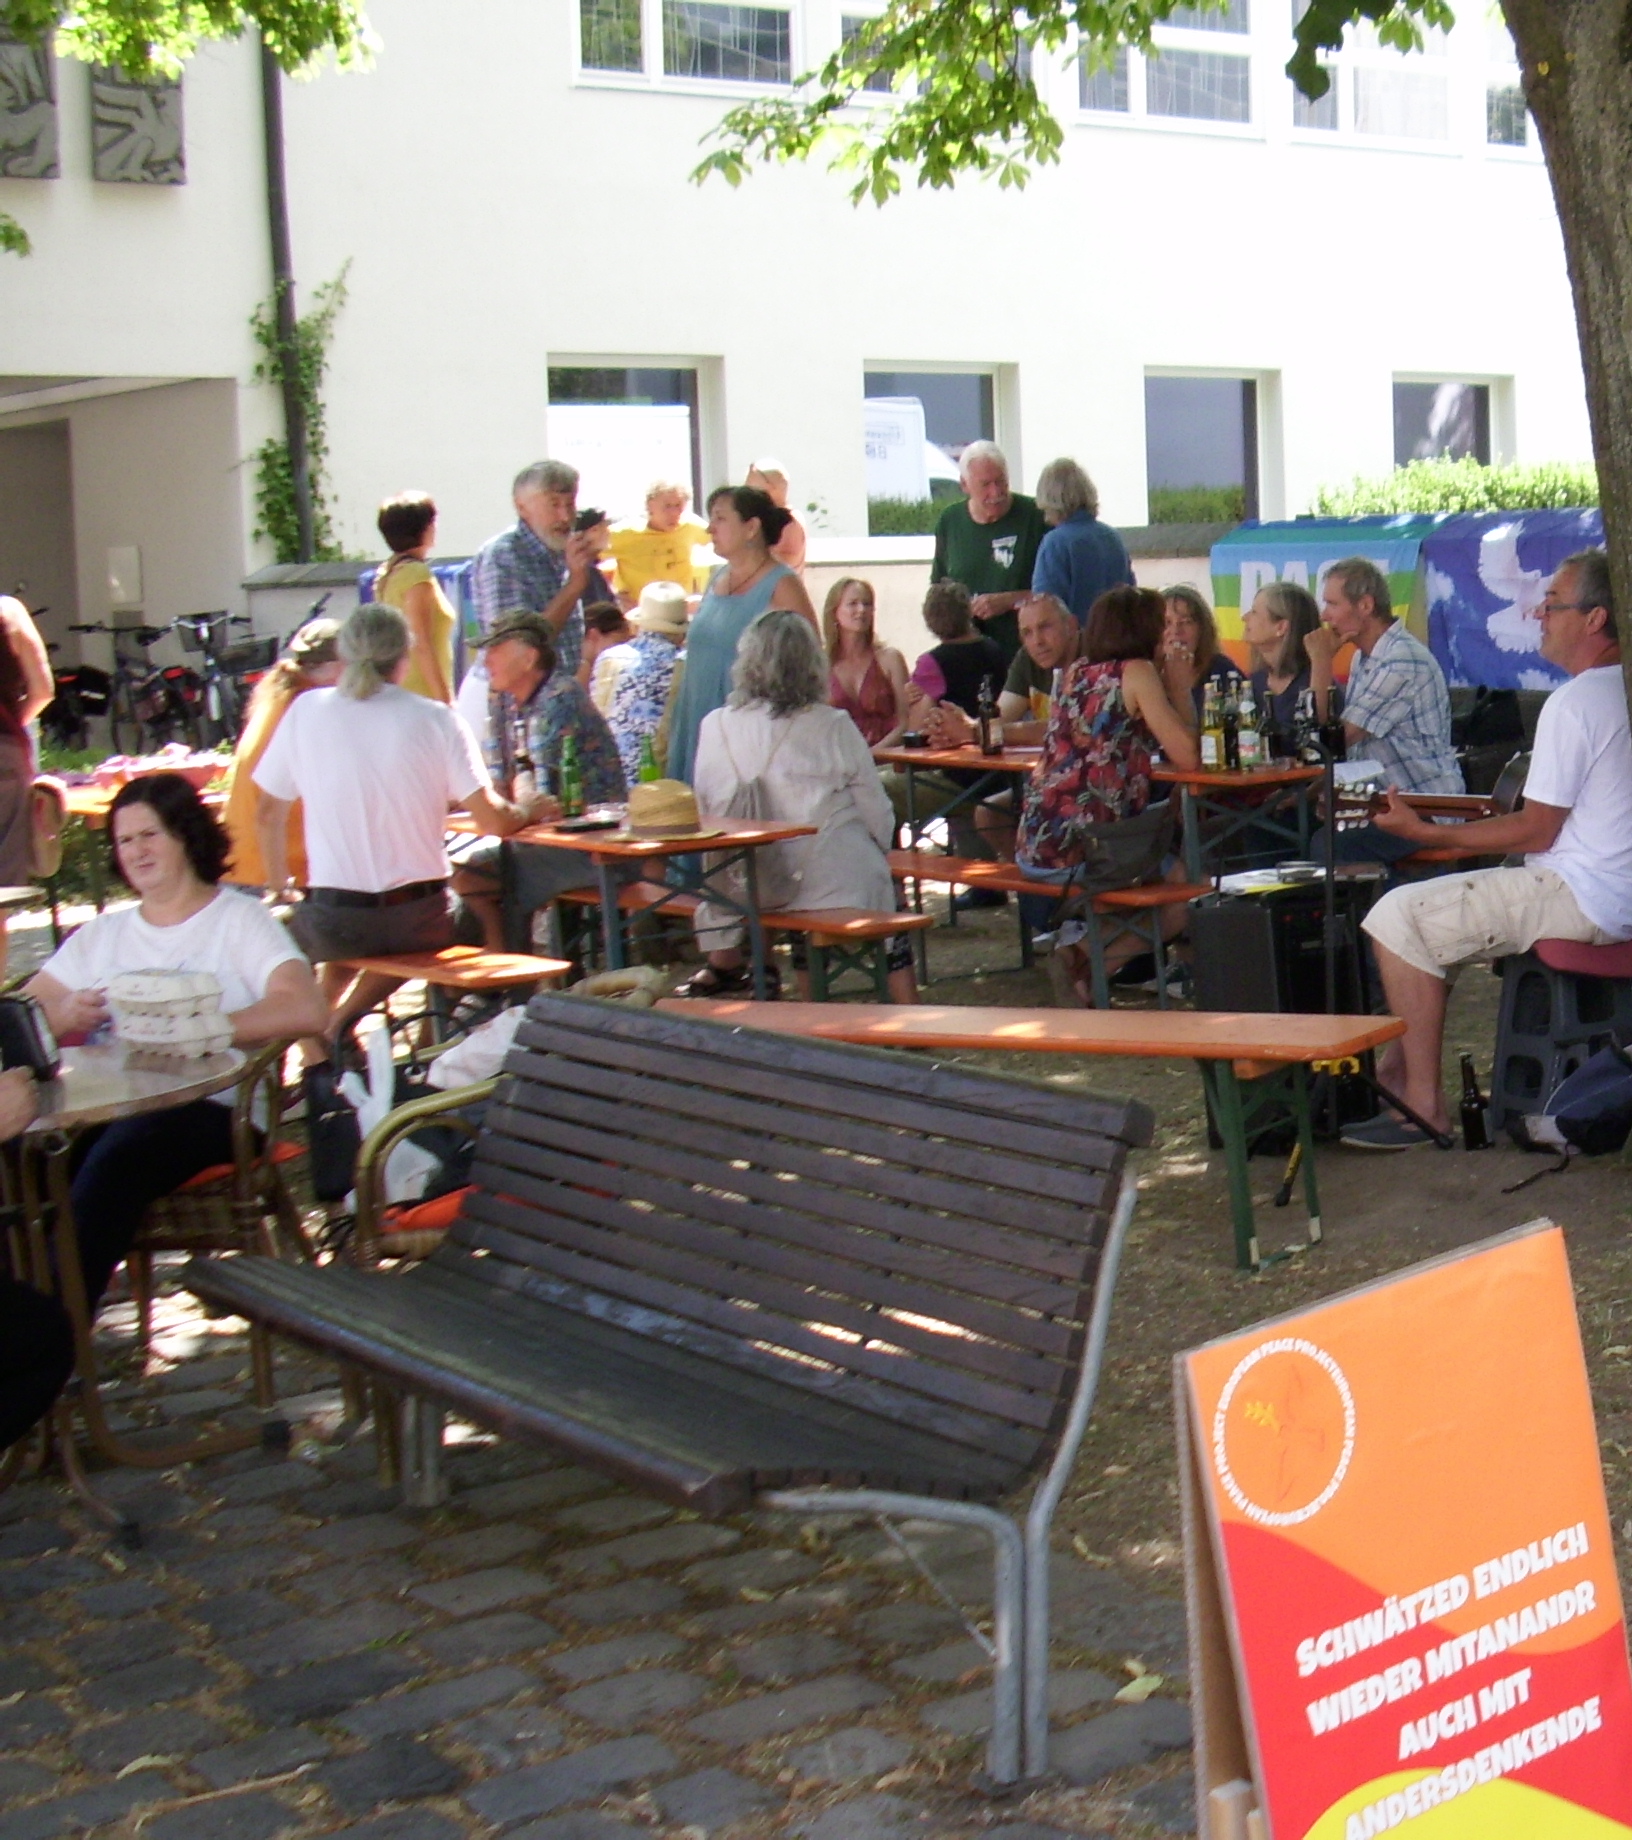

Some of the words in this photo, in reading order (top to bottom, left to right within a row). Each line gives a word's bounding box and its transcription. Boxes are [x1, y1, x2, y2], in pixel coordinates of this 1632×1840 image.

[1296, 1573, 1470, 1677] SCHWÄTZED
[1473, 1522, 1589, 1601] ENDLICH
[1306, 1657, 1423, 1737] WIEDER
[1426, 1580, 1596, 1679] MITANANDR
[1345, 1697, 1602, 1840] ANDERSDENKENDE
[1399, 1693, 1477, 1762] AUCH
[1480, 1669, 1532, 1720] MIT
